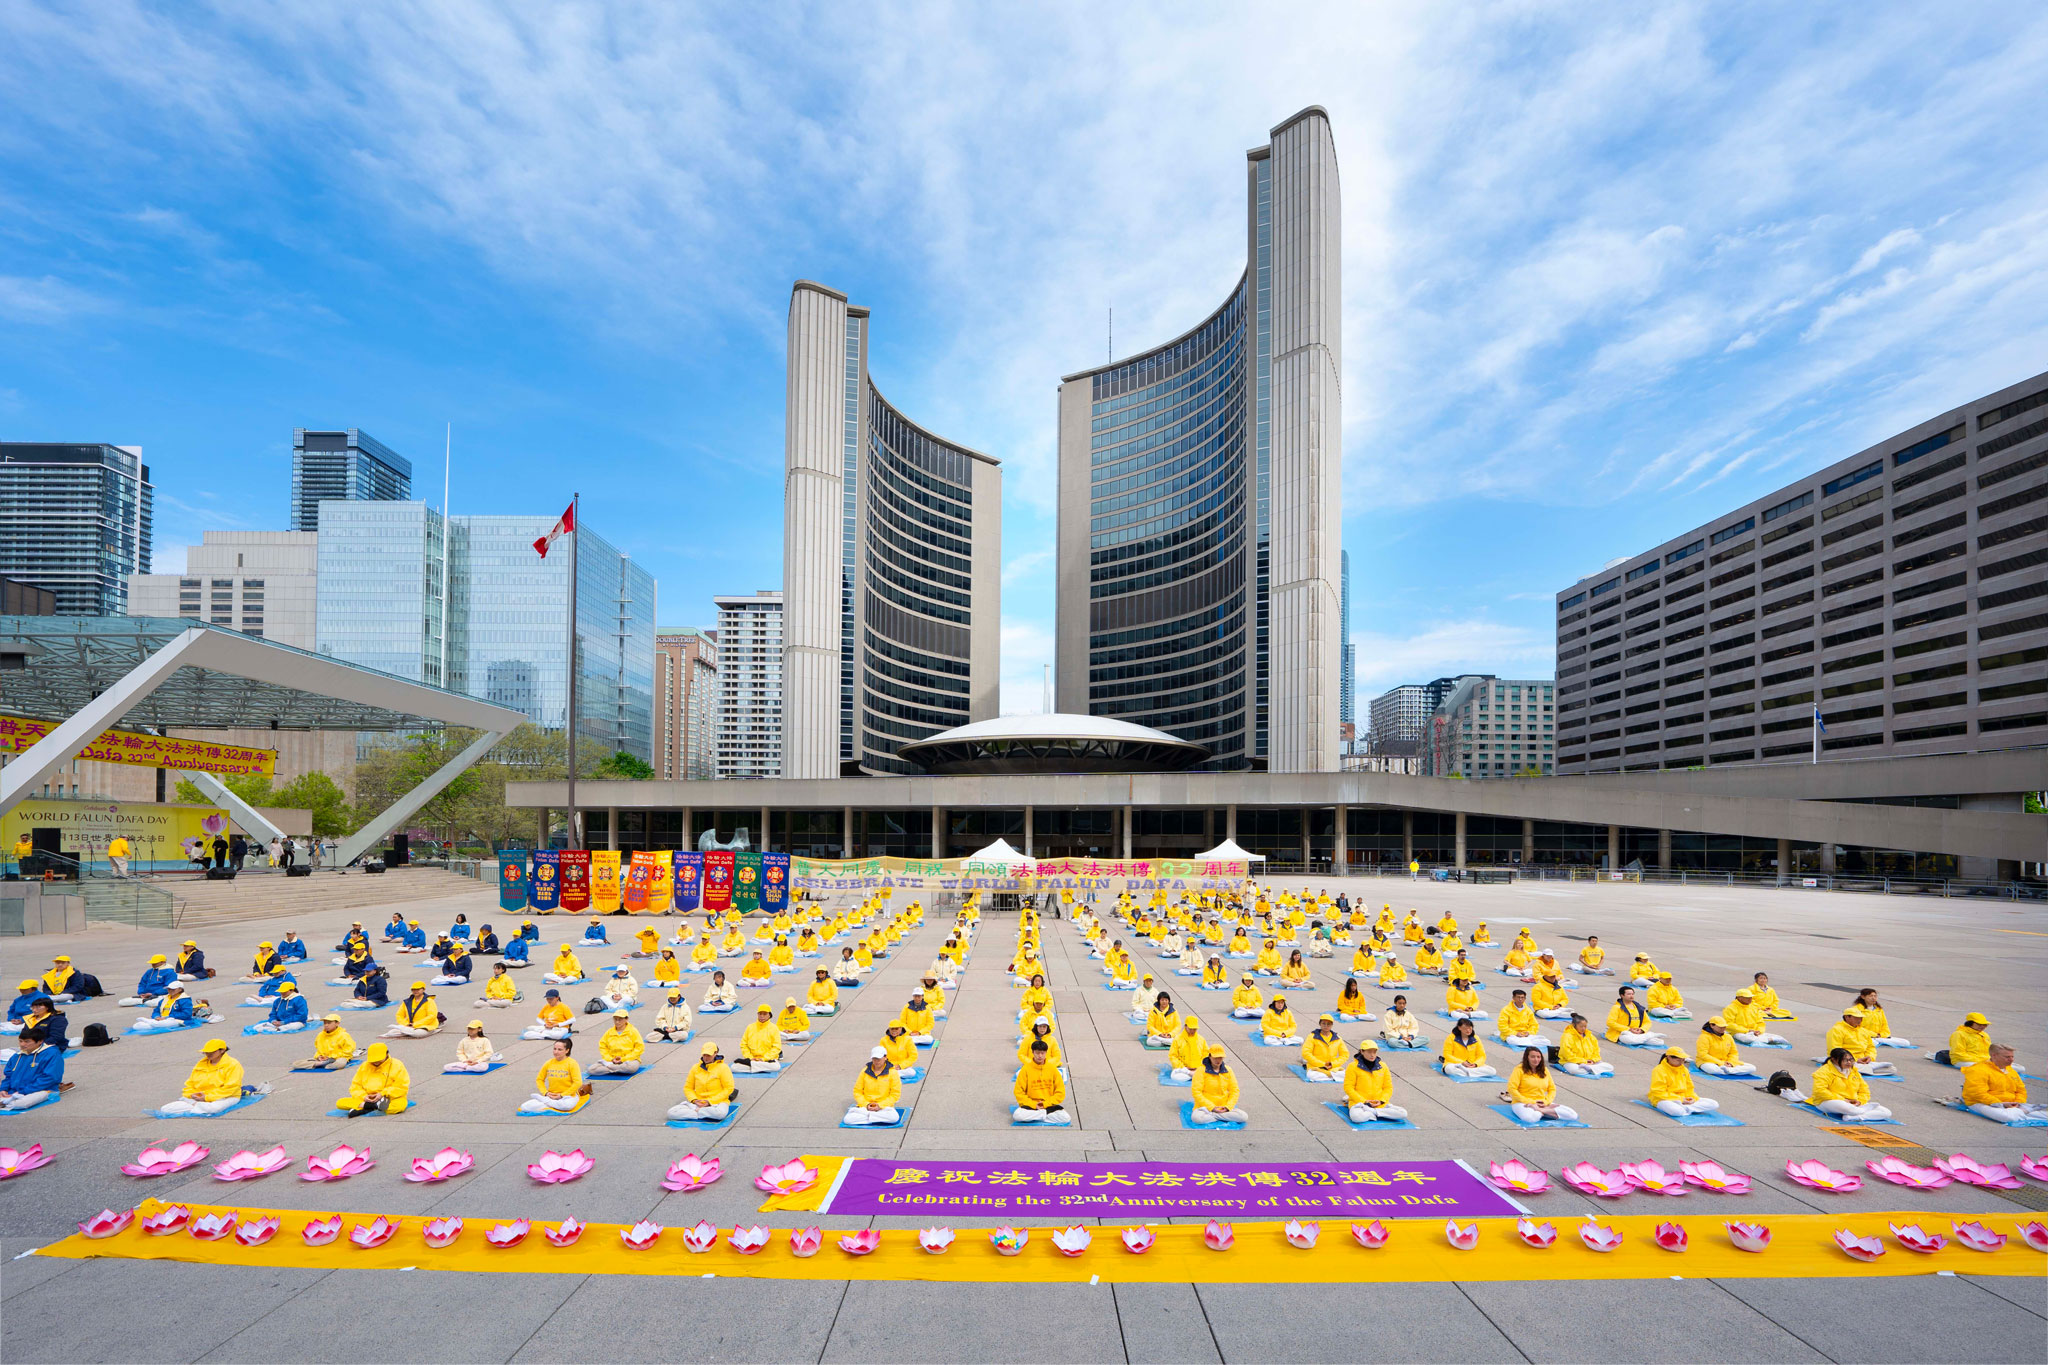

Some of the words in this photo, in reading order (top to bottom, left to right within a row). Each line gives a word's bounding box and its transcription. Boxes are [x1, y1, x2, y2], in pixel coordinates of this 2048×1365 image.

[91, 732, 268, 763] 法輪大法洪傳32周年
[79, 746, 122, 760] Dafa
[128, 751, 155, 762] 32nd
[160, 755, 249, 775] Anniversary
[19, 811, 70, 821] WORLD
[74, 813, 112, 823] FALUN
[116, 815, 144, 824] DAFA
[147, 815, 169, 824] DAY
[793, 877, 924, 889] CELEBRATE
[940, 878, 1020, 890] WORLD
[1036, 878, 1110, 889] FALUN
[1126, 879, 1187, 889] DAFA
[1201, 878, 1244, 890] DAY
[884, 1168, 1436, 1187] 慶祝法輪大法洪傳32週年
[878, 1193, 1007, 1208] Celebrating
[1016, 1195, 1051, 1206] the
[1059, 1194, 1108, 1206] 32nd
[1110, 1196, 1247, 1209] Anniversary
[1257, 1196, 1279, 1206] of
[1285, 1196, 1323, 1206] the
[1326, 1195, 1398, 1206] Falun
[1400, 1194, 1460, 1206] Dafa
